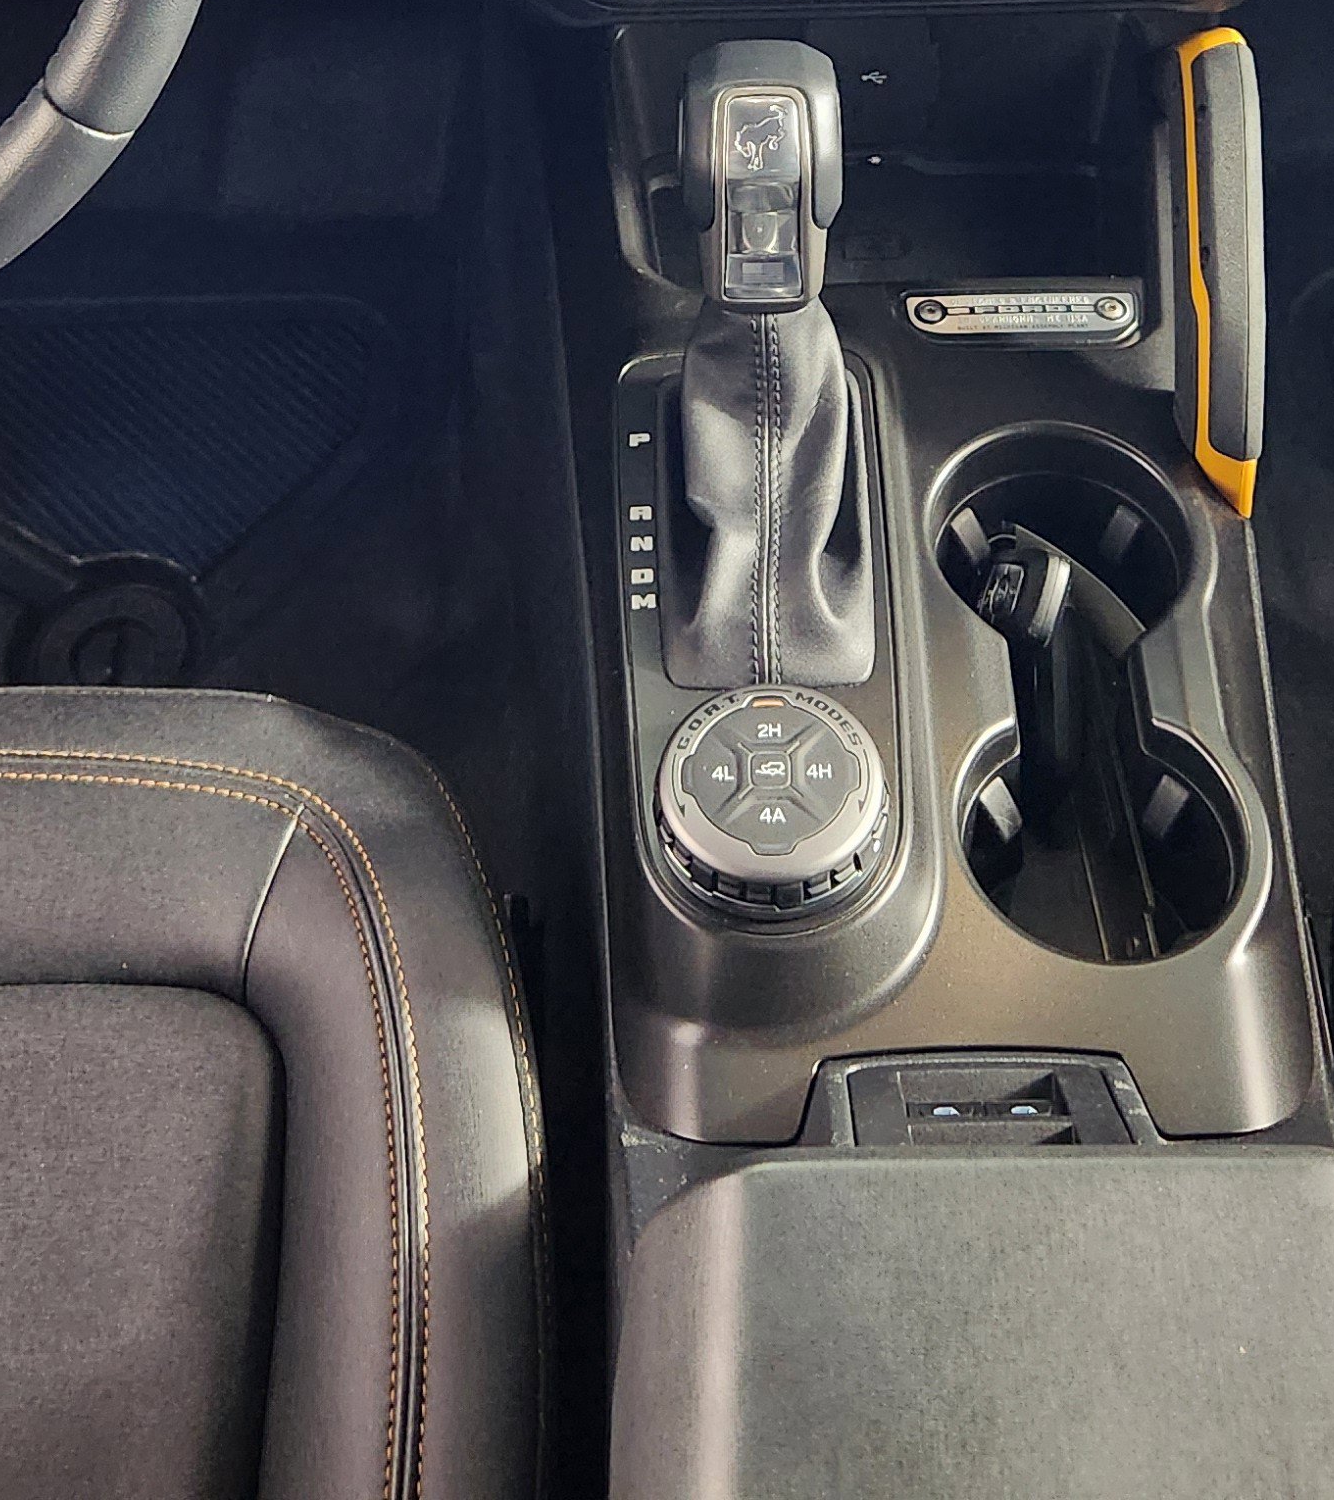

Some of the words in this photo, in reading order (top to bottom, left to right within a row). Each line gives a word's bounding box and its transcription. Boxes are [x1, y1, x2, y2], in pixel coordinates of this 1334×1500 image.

[629, 432, 651, 447] P
[630, 535, 654, 551] N
[631, 568, 654, 584] D
[631, 593, 657, 610] M
[795, 692, 863, 747] MODES
[757, 723, 782, 738] 2H
[711, 765, 735, 782] 4L
[806, 763, 833, 779] 4H
[759, 807, 787, 824] 4A
